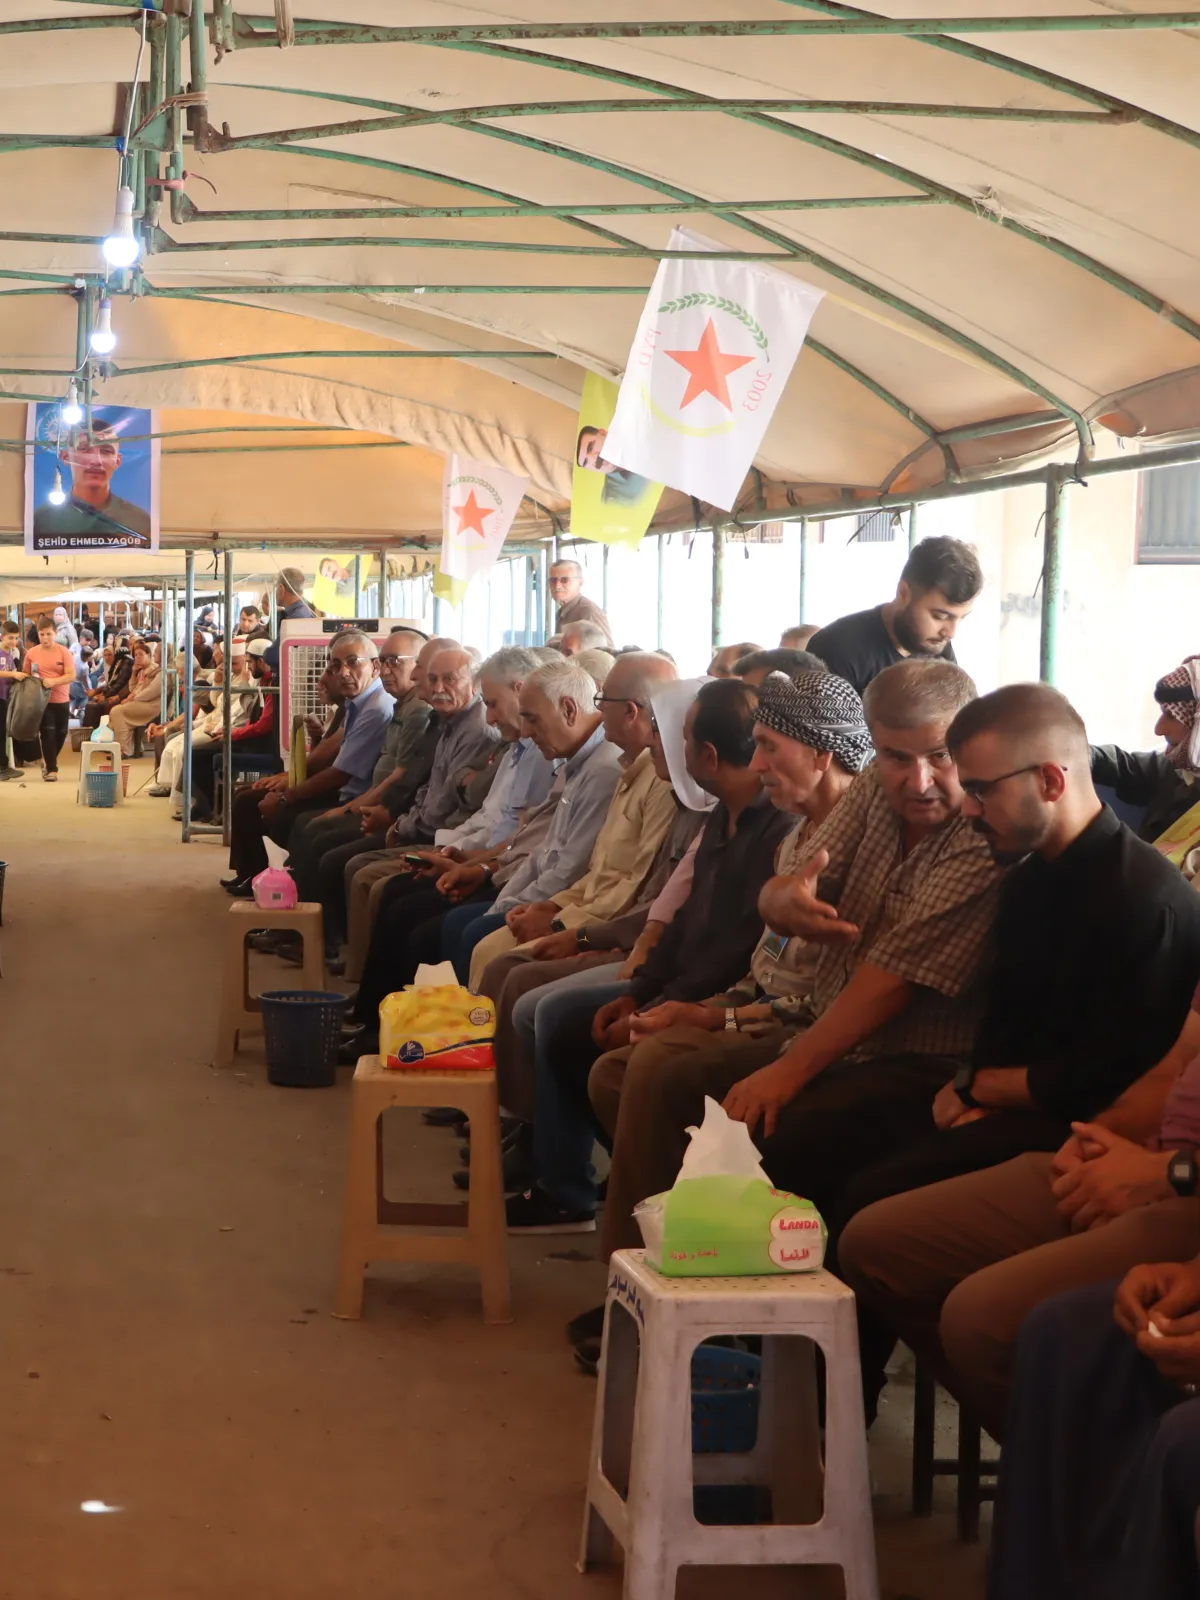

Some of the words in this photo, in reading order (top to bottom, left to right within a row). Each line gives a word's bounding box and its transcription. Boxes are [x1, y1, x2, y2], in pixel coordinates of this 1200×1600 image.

[70, 537, 104, 546] EHMED
[107, 536, 141, 545] YAQÛB
[779, 1218, 820, 1231] LANDA
